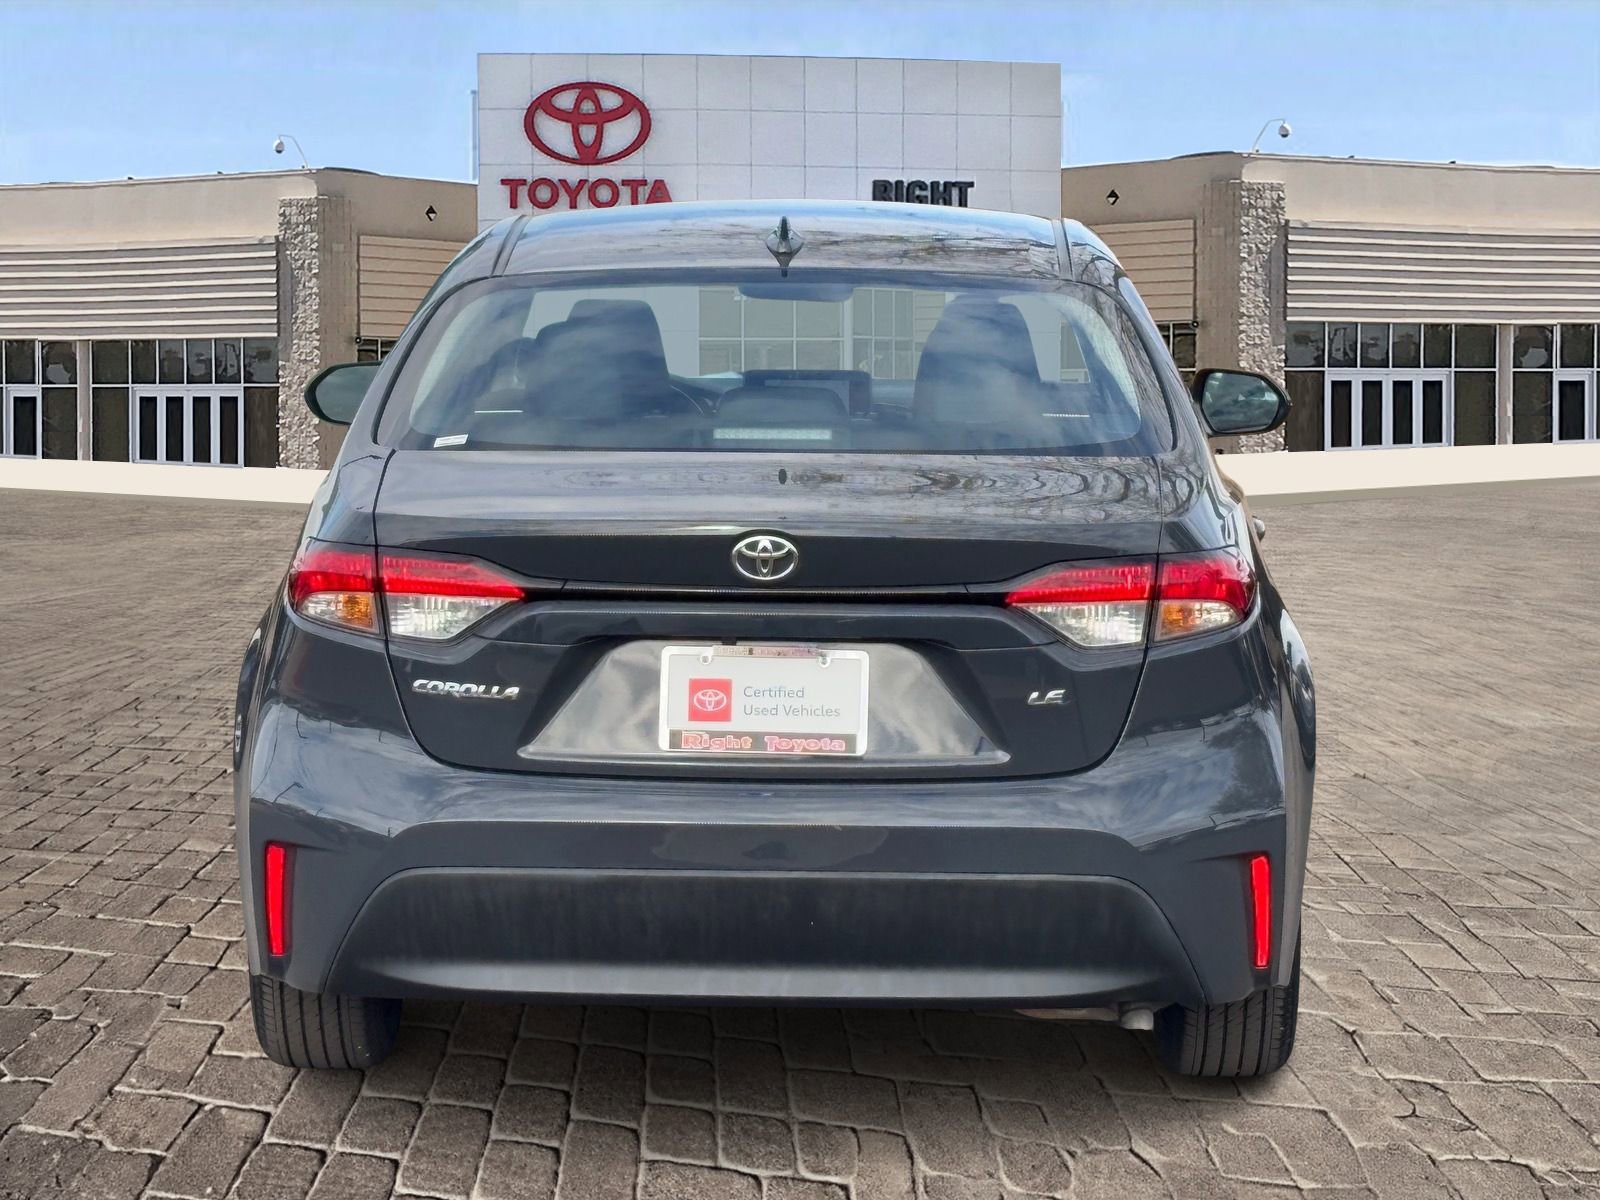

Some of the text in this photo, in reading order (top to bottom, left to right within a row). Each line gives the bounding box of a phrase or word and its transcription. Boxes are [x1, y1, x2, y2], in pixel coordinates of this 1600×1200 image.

[500, 177, 673, 209] TOYOTA
[872, 179, 975, 208] RIGHT
[412, 678, 521, 700] COROLLA
[743, 685, 805, 699] Certified
[1027, 689, 1067, 706] LE
[743, 704, 841, 718] Used Vehicles
[681, 731, 846, 752] Right Toyota
